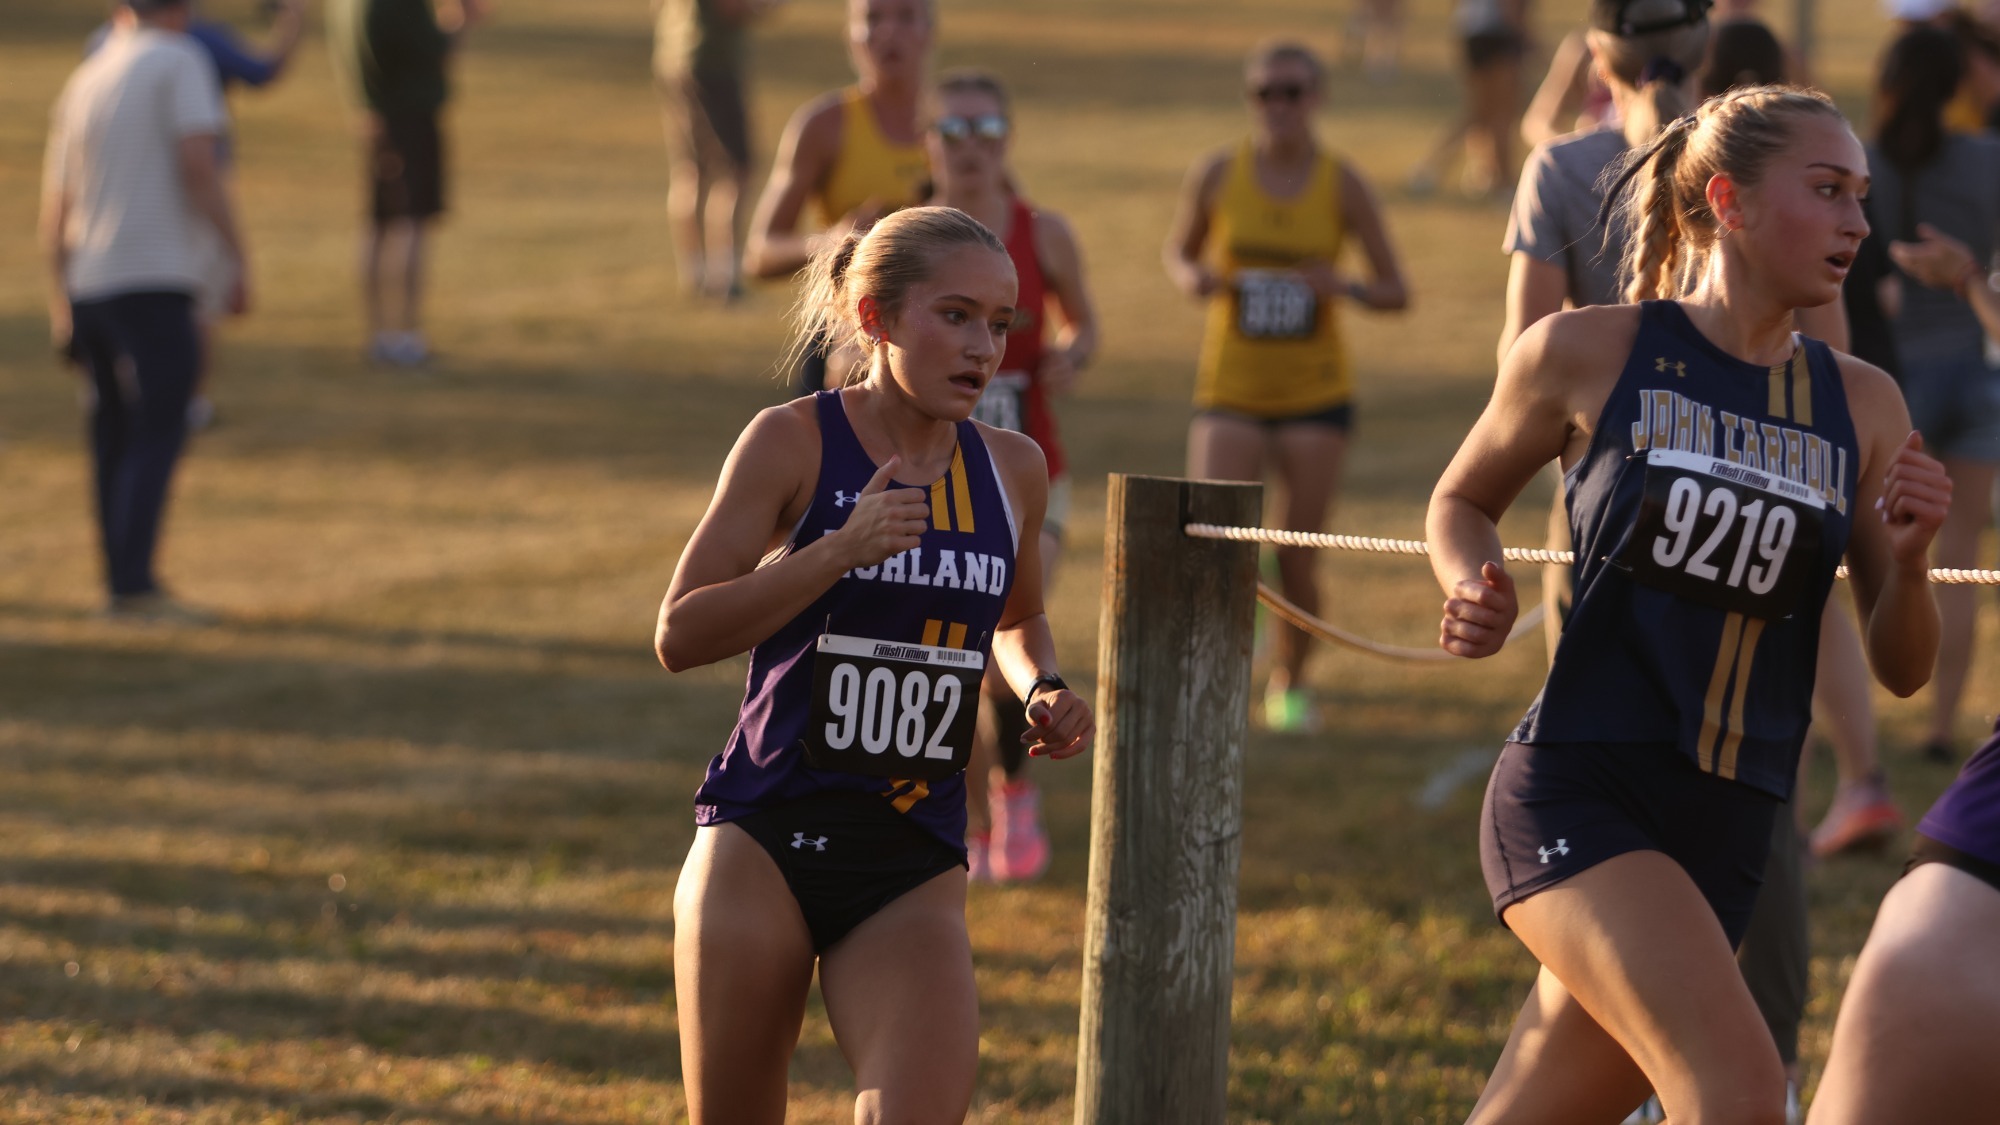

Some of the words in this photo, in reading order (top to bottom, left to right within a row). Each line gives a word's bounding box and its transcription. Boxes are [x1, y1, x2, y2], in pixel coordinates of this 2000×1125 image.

[1631, 389, 1715, 458] JOHN
[1720, 410, 1847, 516] CARROLL
[1709, 461, 1771, 490] FinishTiming
[823, 529, 1006, 596] HLAND
[1651, 476, 1797, 595] 9219
[872, 643, 931, 662] FinishTiming
[824, 662, 962, 760] 9082
